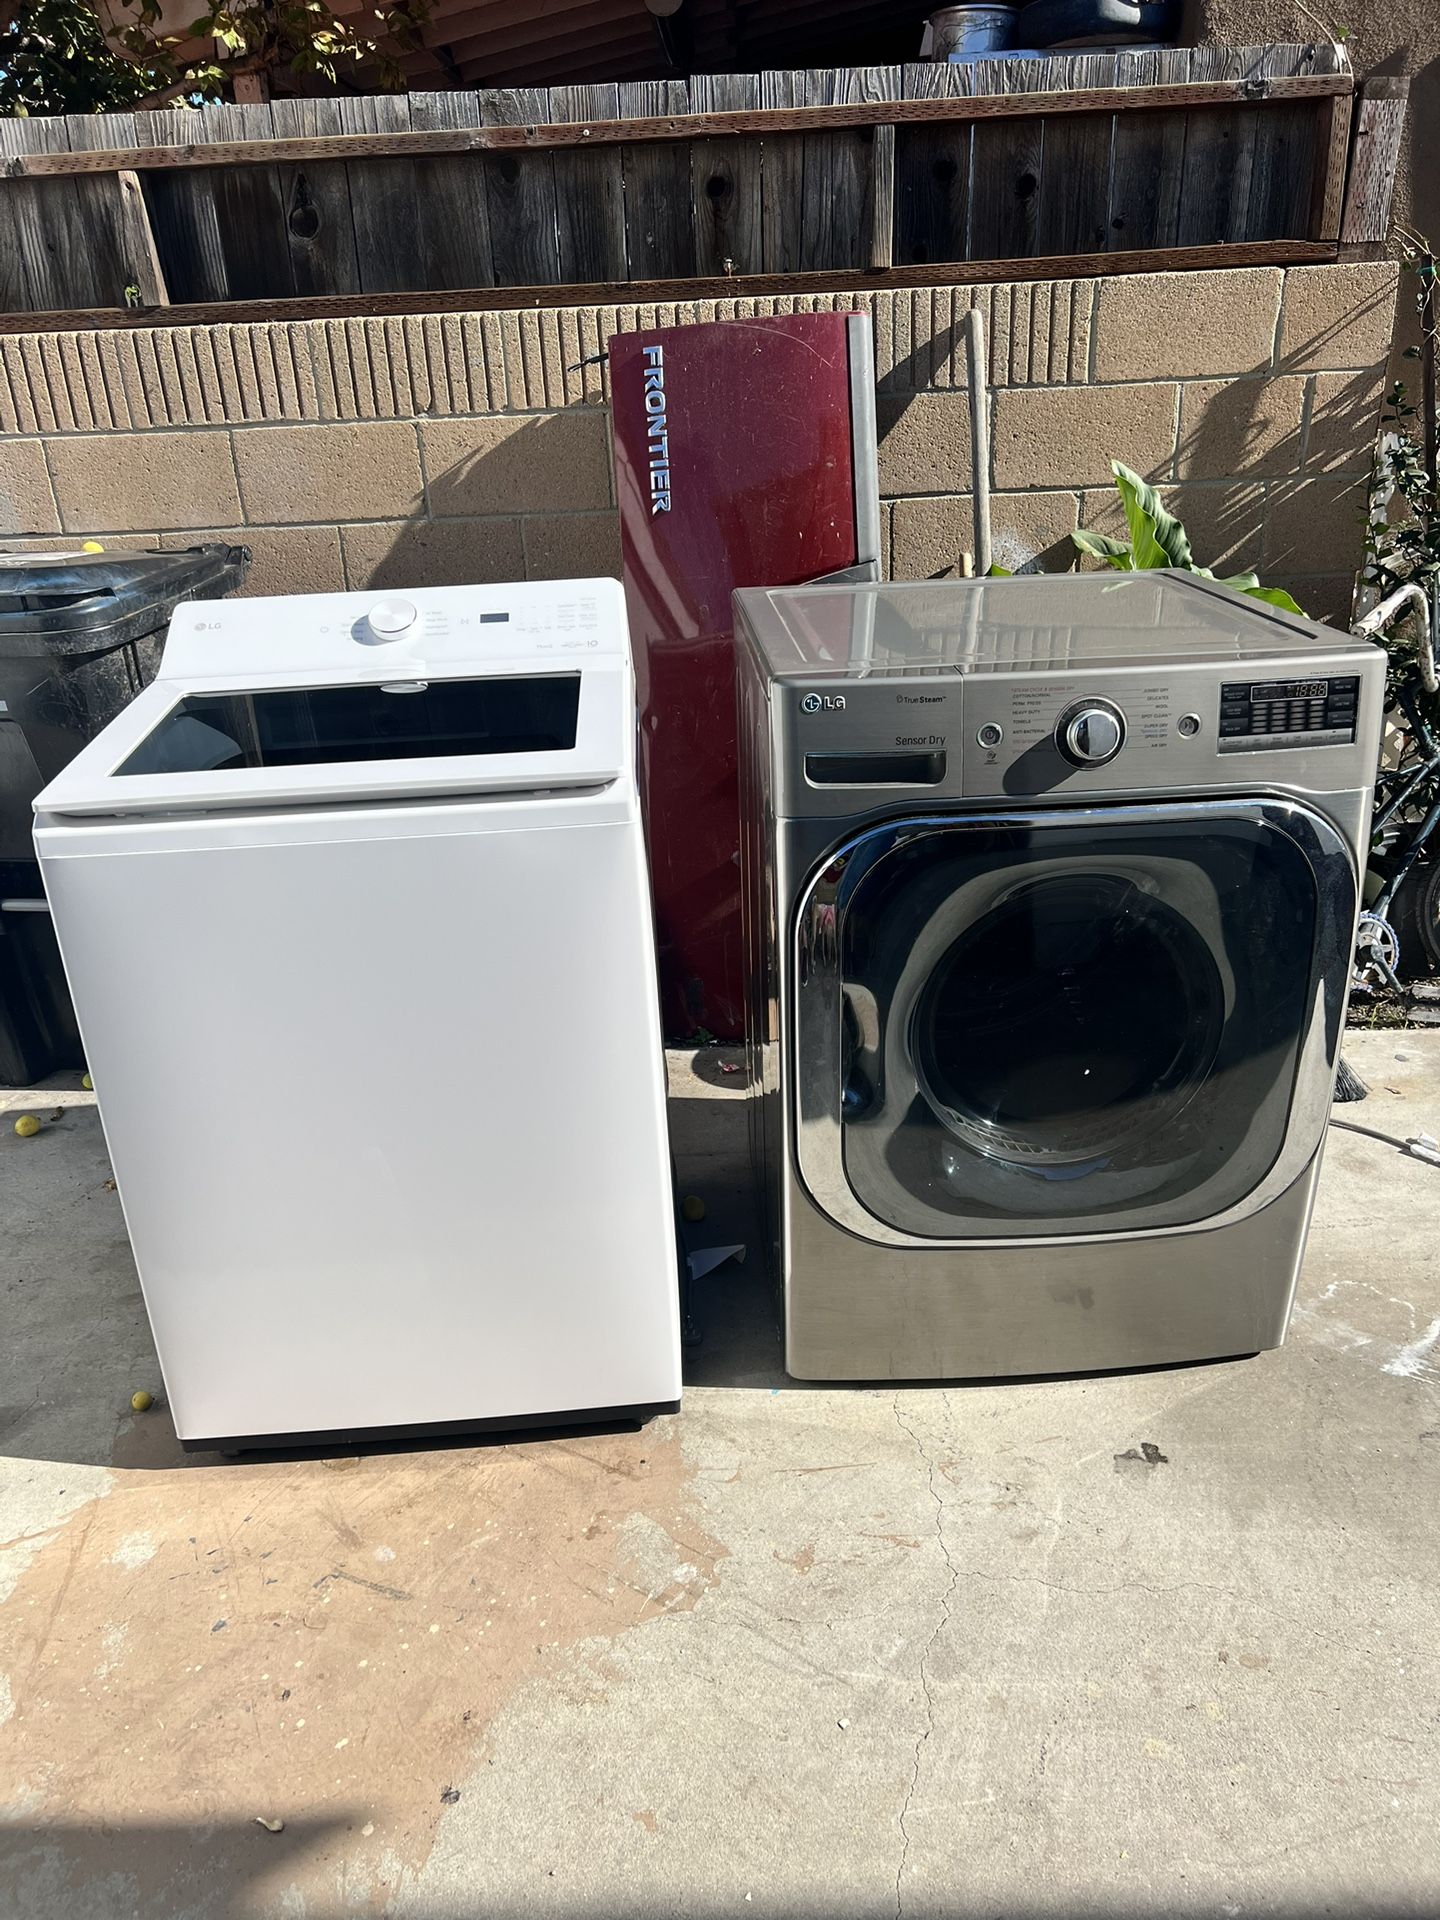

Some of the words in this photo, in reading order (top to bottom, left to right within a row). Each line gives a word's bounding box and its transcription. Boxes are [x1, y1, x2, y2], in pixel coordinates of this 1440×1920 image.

[643, 345, 672, 516] FRONTIER
[895, 736, 926, 746] Sensor
[929, 735, 946, 747] Dry
